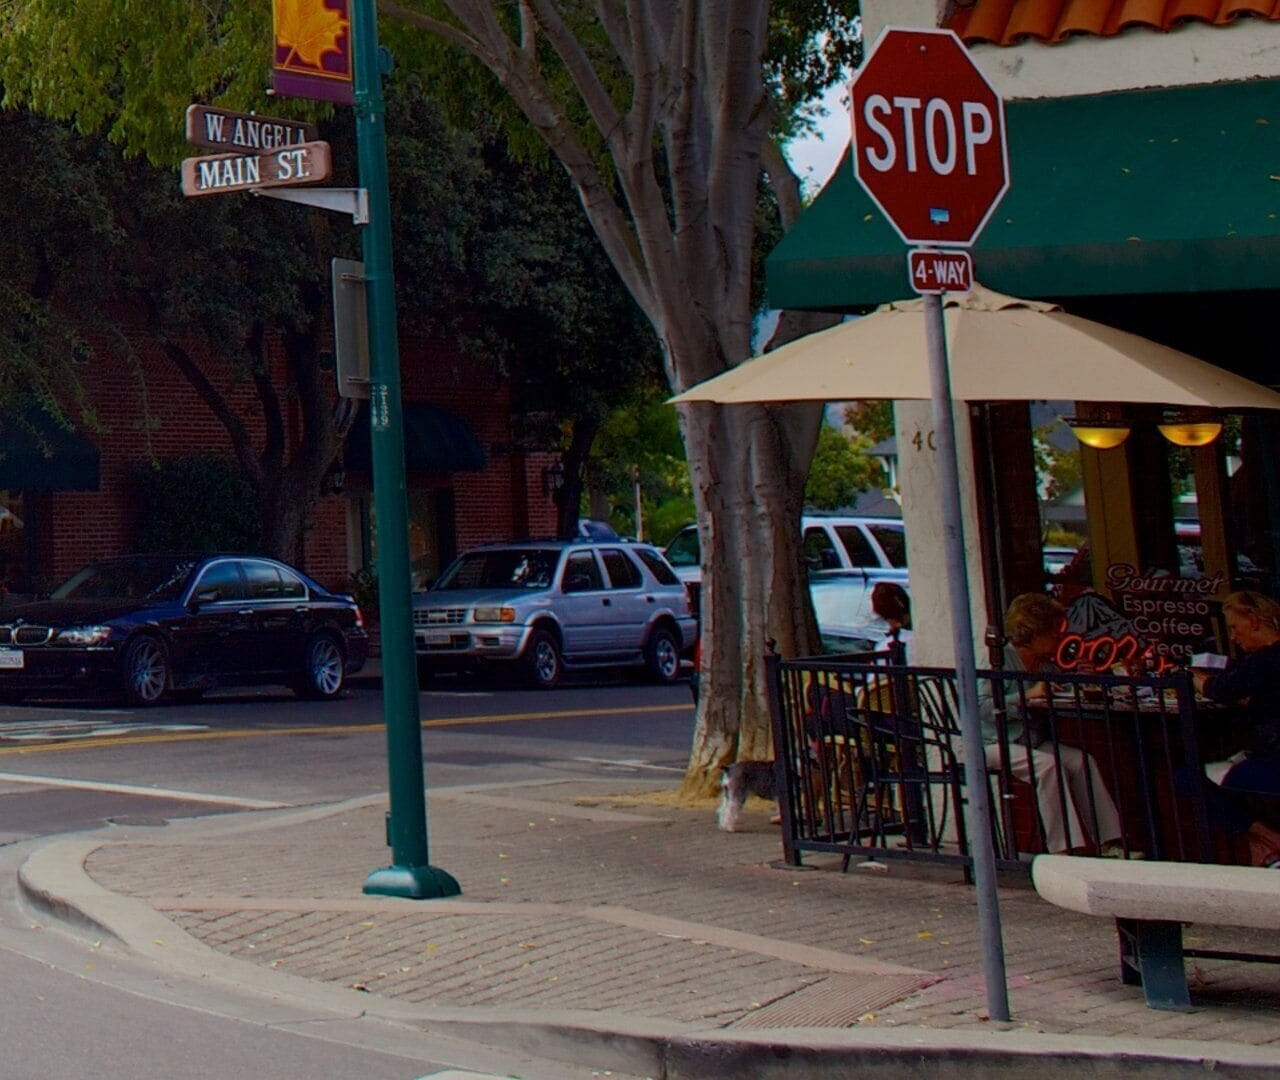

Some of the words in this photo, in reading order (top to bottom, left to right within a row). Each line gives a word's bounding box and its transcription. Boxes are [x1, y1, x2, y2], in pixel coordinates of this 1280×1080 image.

[205, 112, 227, 142] W.
[864, 93, 993, 176] STOP
[199, 155, 261, 190] MAIN
[277, 149, 310, 180] ST.
[915, 259, 966, 285] 4-WAY
[1107, 563, 1224, 594] Gourmet
[1123, 594, 1209, 615] Espresso
[1134, 616, 1204, 636] Coffee
[1147, 637, 1193, 657] Teas
